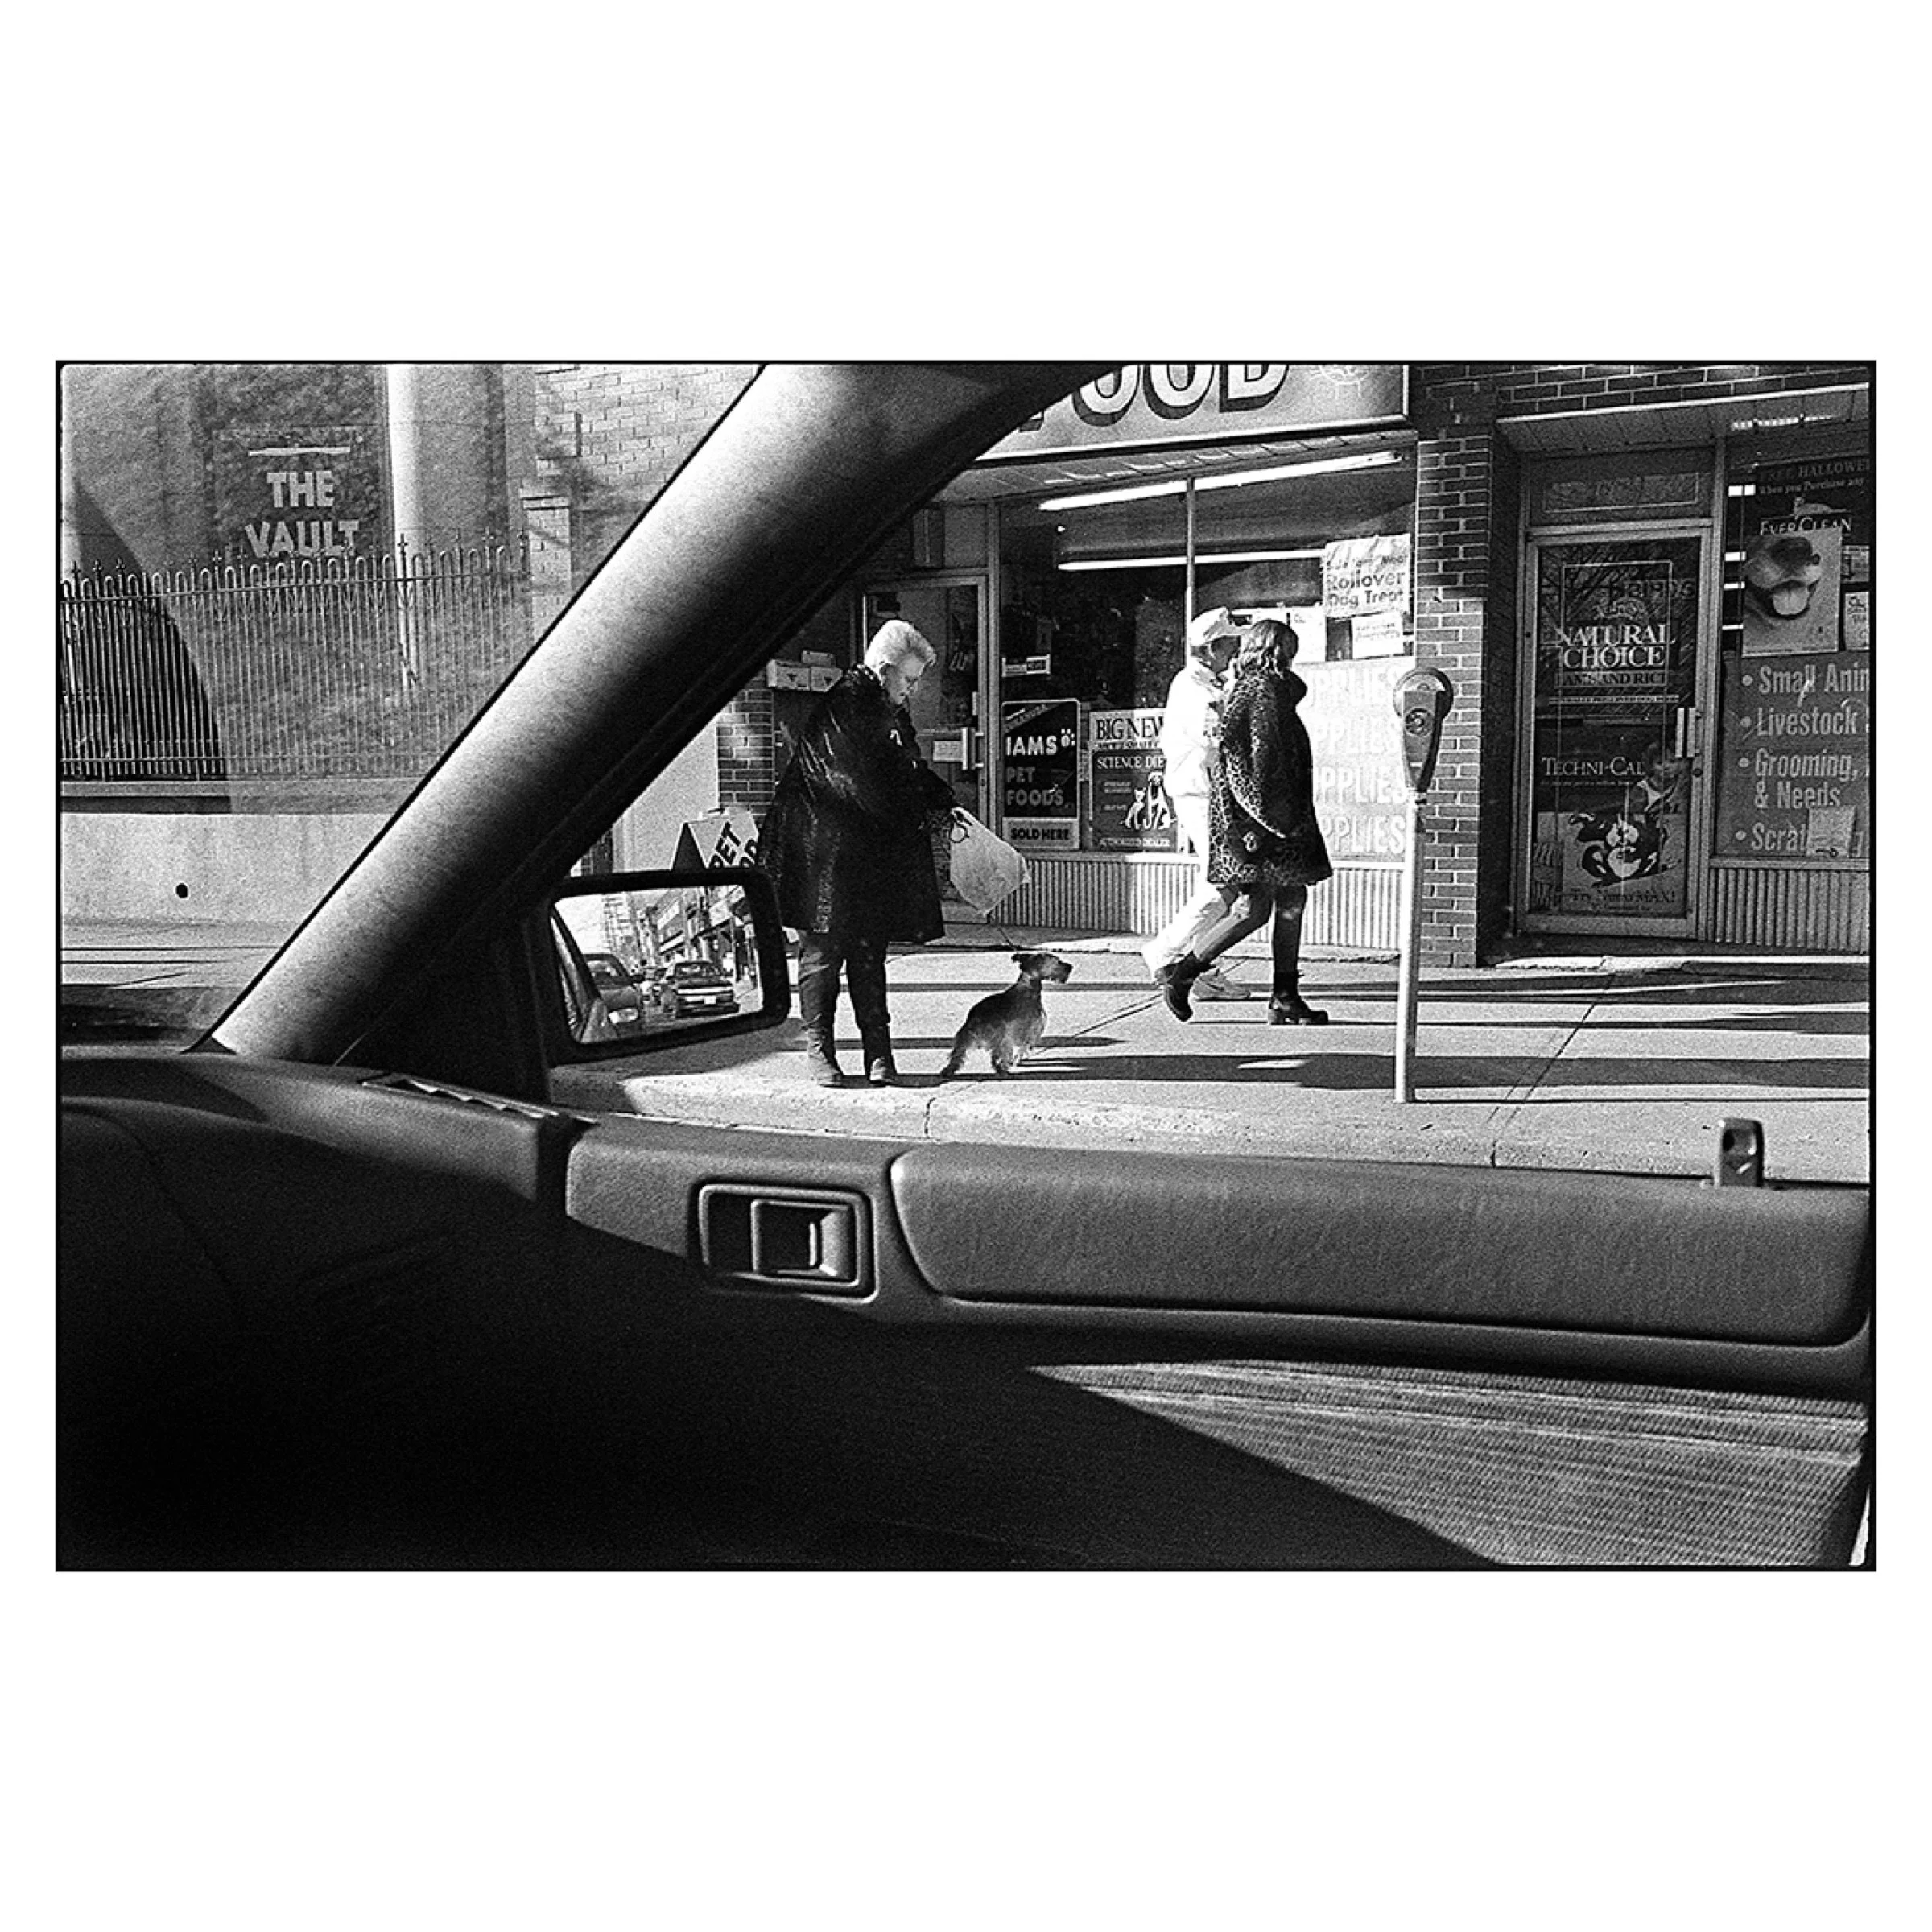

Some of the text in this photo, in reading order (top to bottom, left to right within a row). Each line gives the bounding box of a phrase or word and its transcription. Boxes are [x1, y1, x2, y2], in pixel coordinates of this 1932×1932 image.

[266, 470, 335, 508] THE
[244, 520, 360, 559] VAULT
[1327, 572, 1406, 592] Rollover
[1328, 592, 1359, 609] Dog
[1555, 623, 1676, 647] NATURAL
[1563, 645, 1665, 668] CHOICE
[1758, 664, 1817, 695] Small
[1096, 717, 1124, 740] BIG
[1757, 706, 1858, 737] Livestock
[1006, 735, 1057, 756] IAMS
[1096, 754, 1166, 770] SCIENCE DIE
[1755, 747, 1858, 783] Grooming,
[1006, 766, 1036, 783] PET
[1006, 789, 1064, 806] FOODS
[1754, 779, 1842, 810] & Needs
[1010, 828, 1070, 841] SOLD HERE
